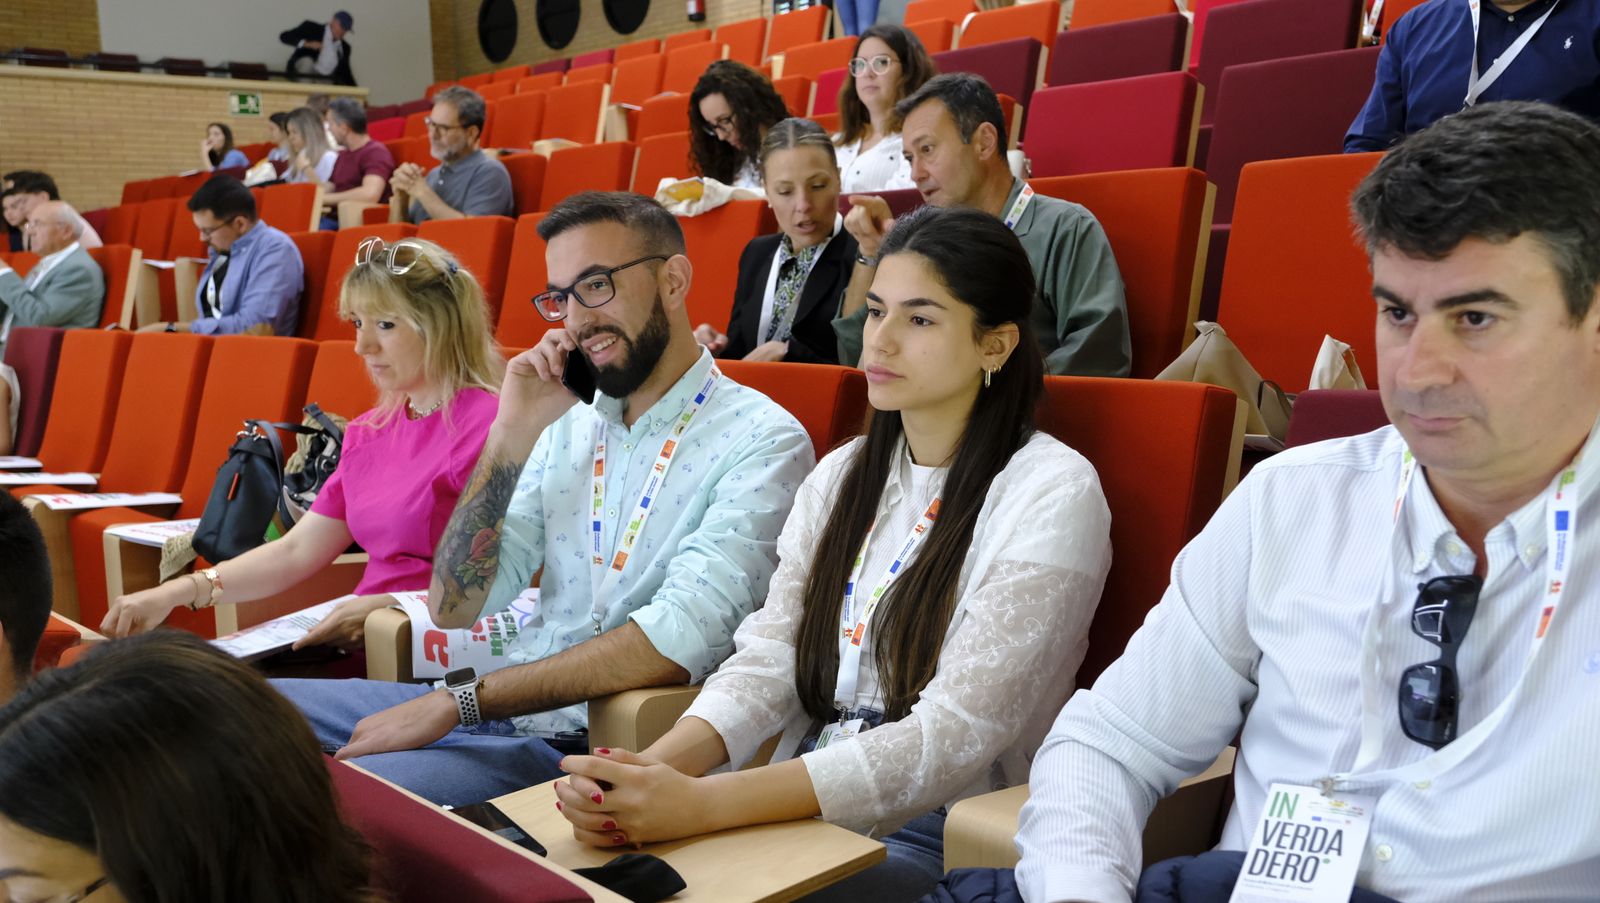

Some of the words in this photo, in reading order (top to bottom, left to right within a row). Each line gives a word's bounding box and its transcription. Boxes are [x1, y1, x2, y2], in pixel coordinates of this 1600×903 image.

[1268, 791, 1299, 820] IN
[1262, 819, 1343, 857] VERDA
[1248, 848, 1320, 883] DERO
